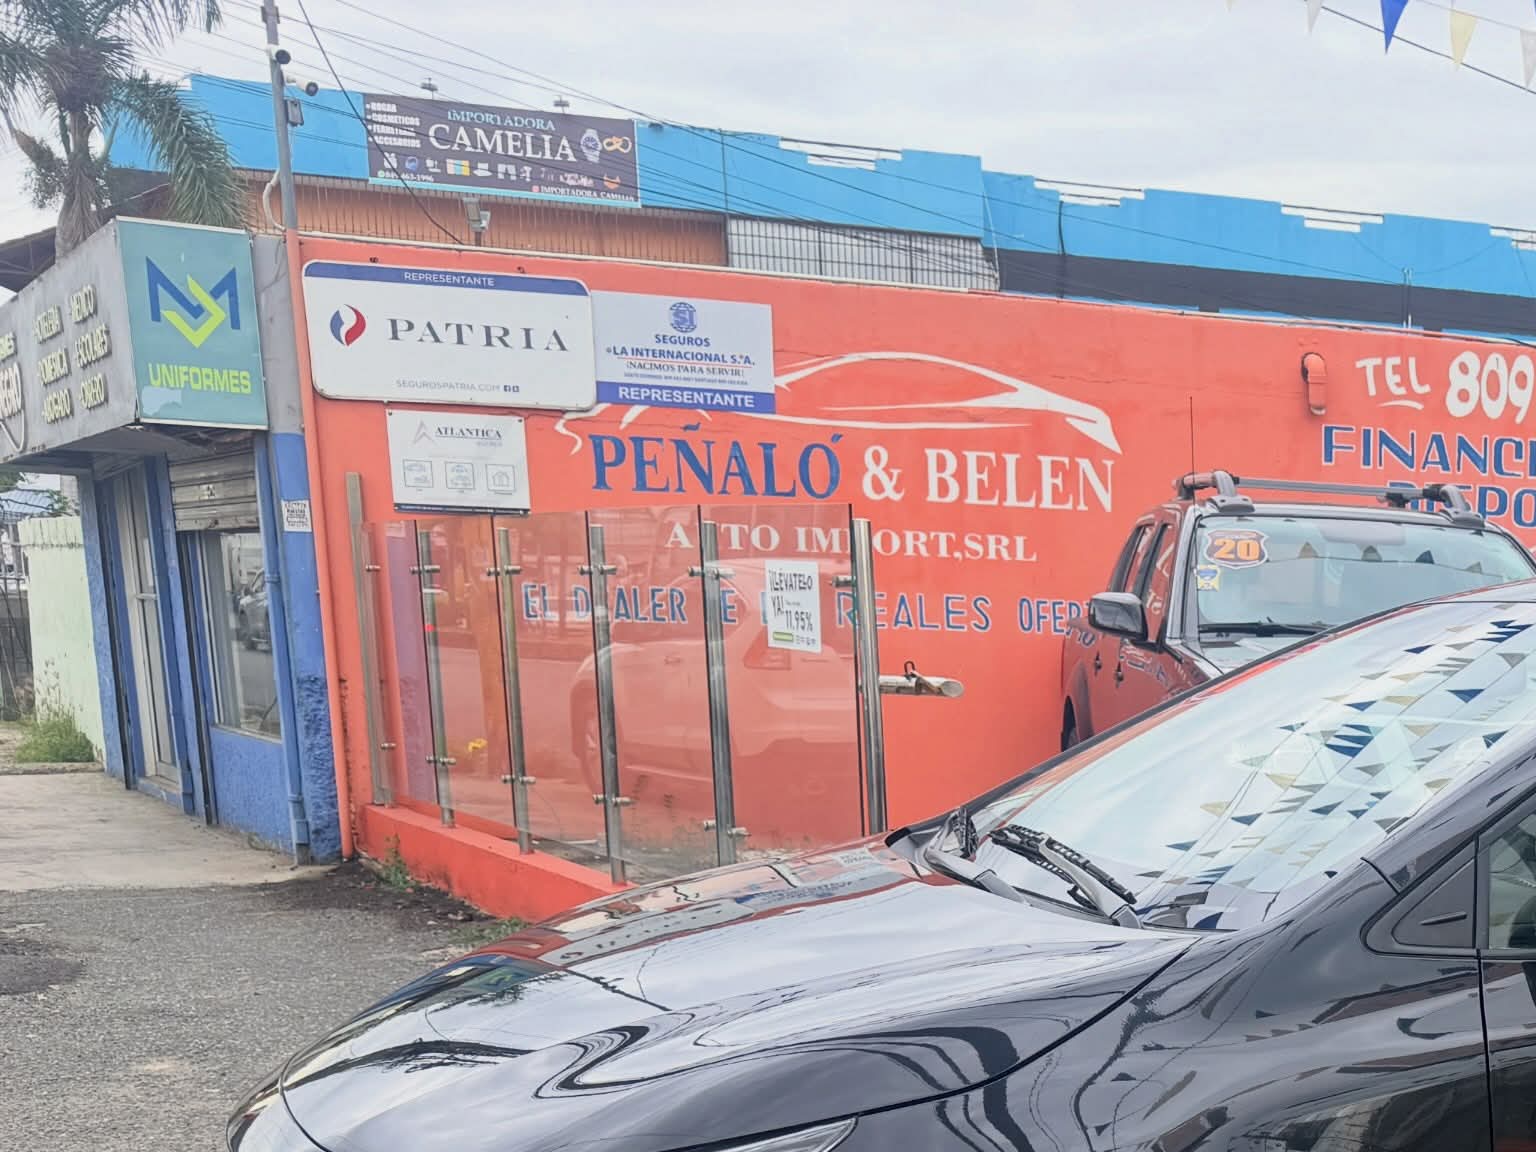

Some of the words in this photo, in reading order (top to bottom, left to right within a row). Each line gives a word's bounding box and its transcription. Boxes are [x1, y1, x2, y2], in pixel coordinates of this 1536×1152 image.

[447, 110, 556, 131] IMPORTADORA
[428, 123, 577, 162] CAMELIA
[404, 271, 495, 287] REPRESENTANTE
[386, 318, 569, 352] PATRIA
[655, 334, 711, 348] SEGUROS
[631, 347, 728, 364] INTERNACIONAL
[148, 363, 252, 395] UNIFORMES
[677, 364, 704, 375] PARA
[396, 379, 500, 392] SEGUROSPATRIA.COM
[618, 386, 755, 407] REPRESENTANTE
[1355, 356, 1431, 397] TEL
[1445, 351, 1535, 424] 809
[435, 426, 502, 440] ATLANTICA
[862, 445, 905, 502] &
[924, 447, 1115, 513] BELEN
[664, 521, 780, 551] ATO
[795, 527, 1037, 562] IMORT,SRL
[1214, 538, 1260, 561] 20
[522, 583, 559, 622] EL
[572, 585, 688, 624] DALER
